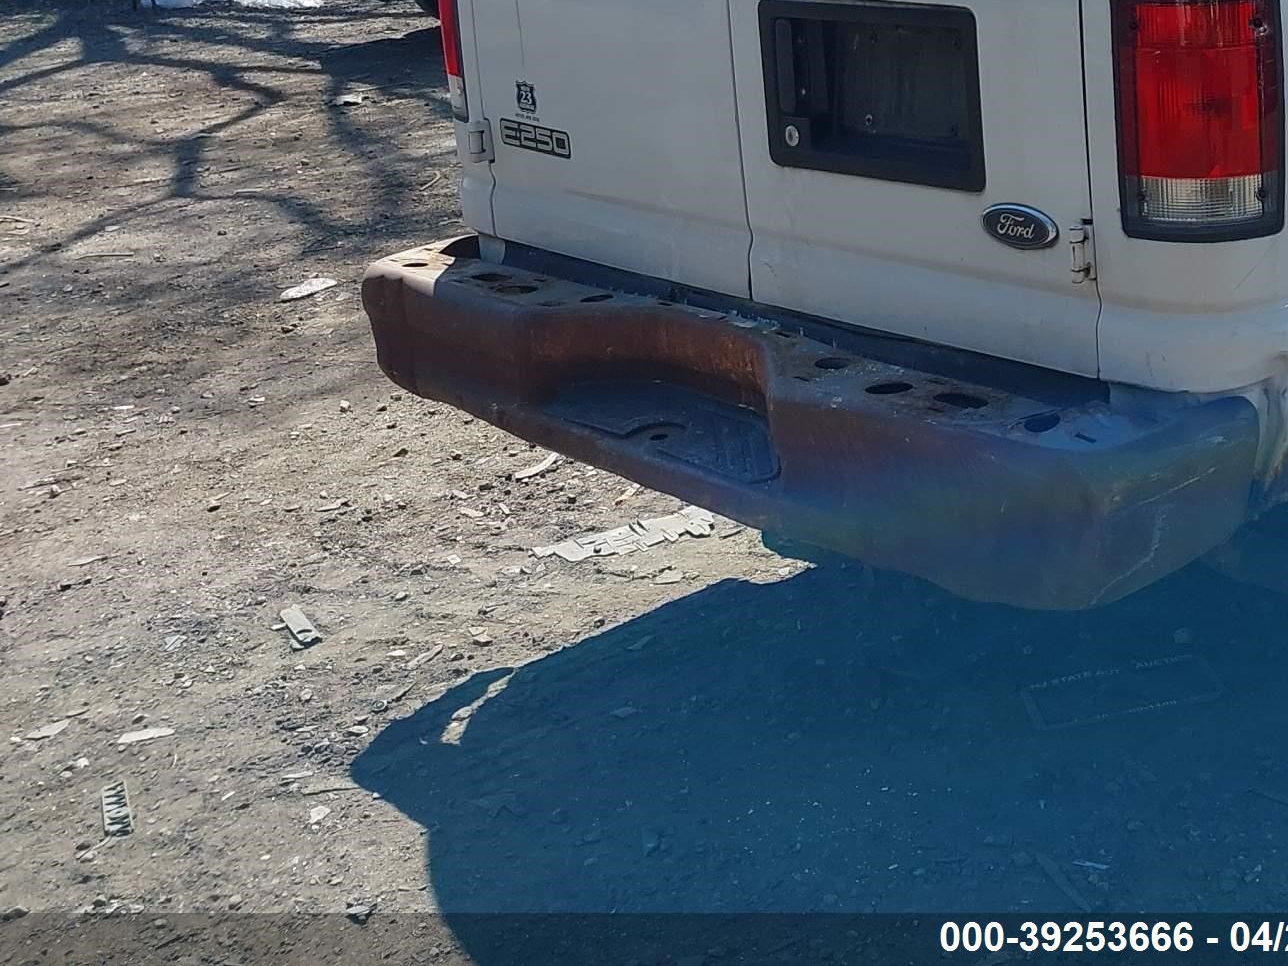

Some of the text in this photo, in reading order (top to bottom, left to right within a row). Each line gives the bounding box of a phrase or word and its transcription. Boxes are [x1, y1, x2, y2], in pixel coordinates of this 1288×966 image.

[520, 90, 532, 104] 23
[501, 120, 569, 155] E-250
[996, 213, 1035, 239] Ford
